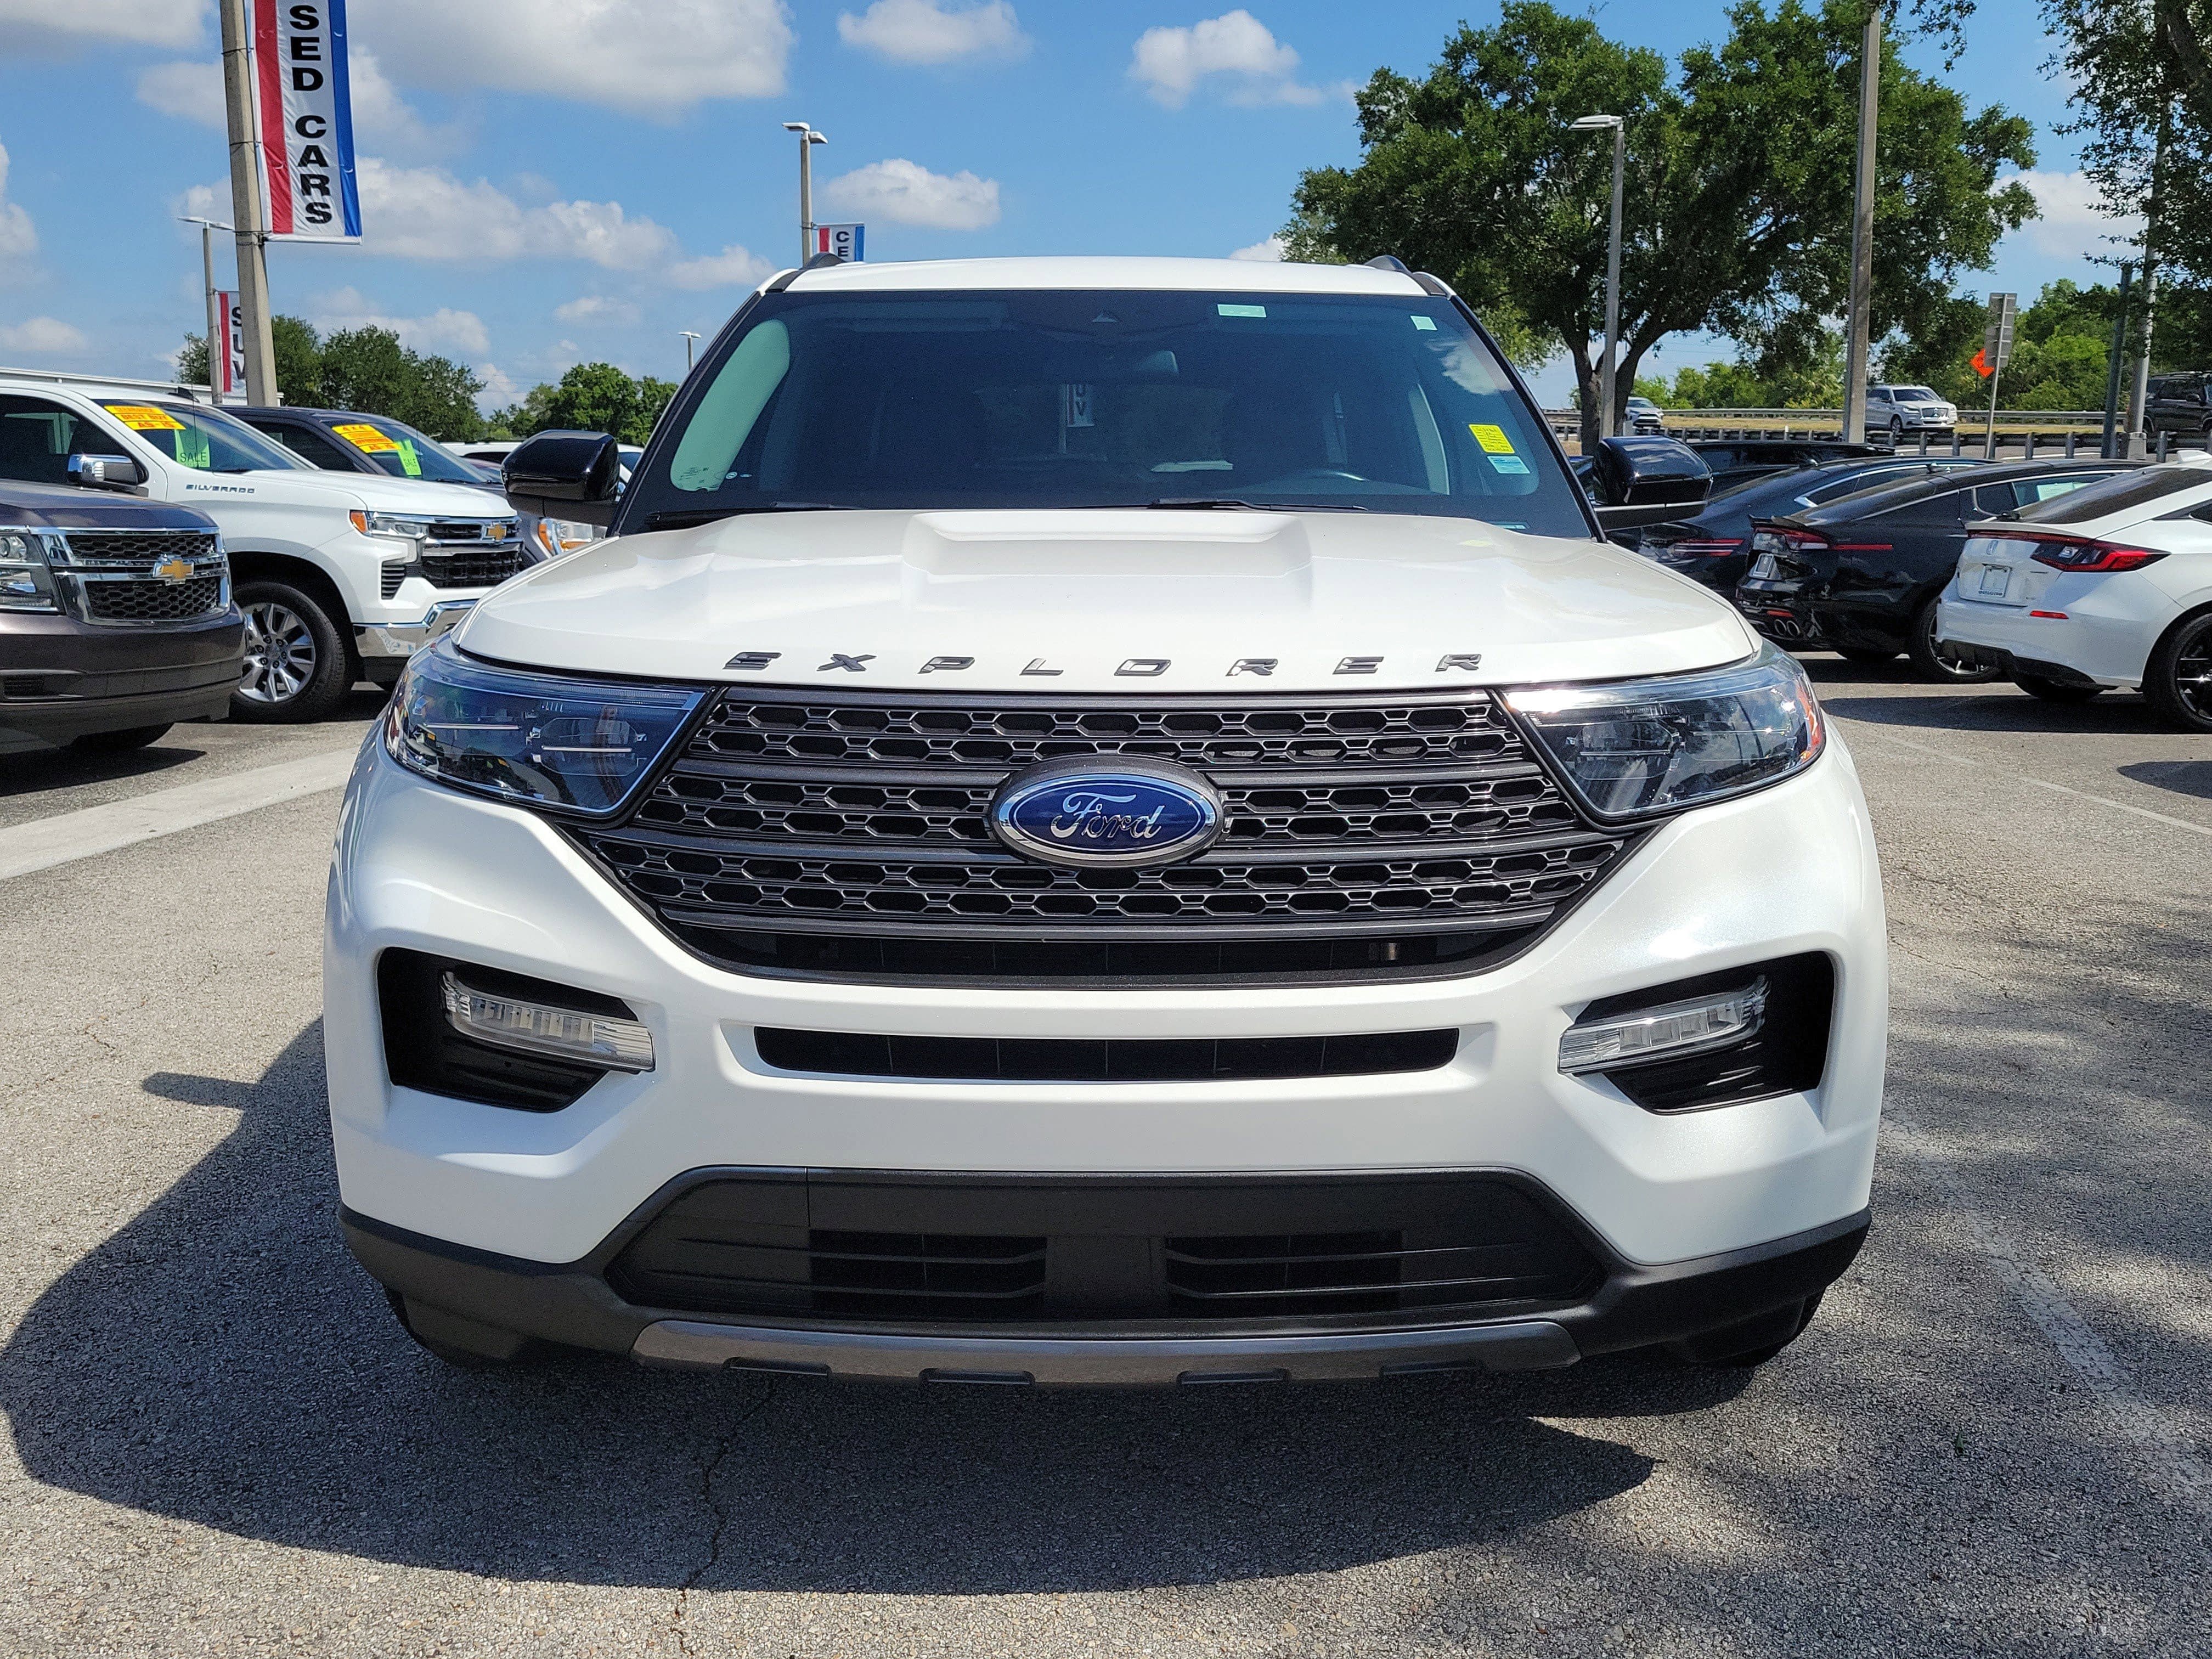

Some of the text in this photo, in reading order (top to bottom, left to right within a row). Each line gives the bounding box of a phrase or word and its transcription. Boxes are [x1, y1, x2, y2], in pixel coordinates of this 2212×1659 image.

[295, 115, 334, 224] CARS
[180, 452, 207, 462] SALE
[186, 484, 255, 493] SILVERADO
[722, 651, 1483, 677] EXPLORER
[1050, 792, 1165, 838] Ford
